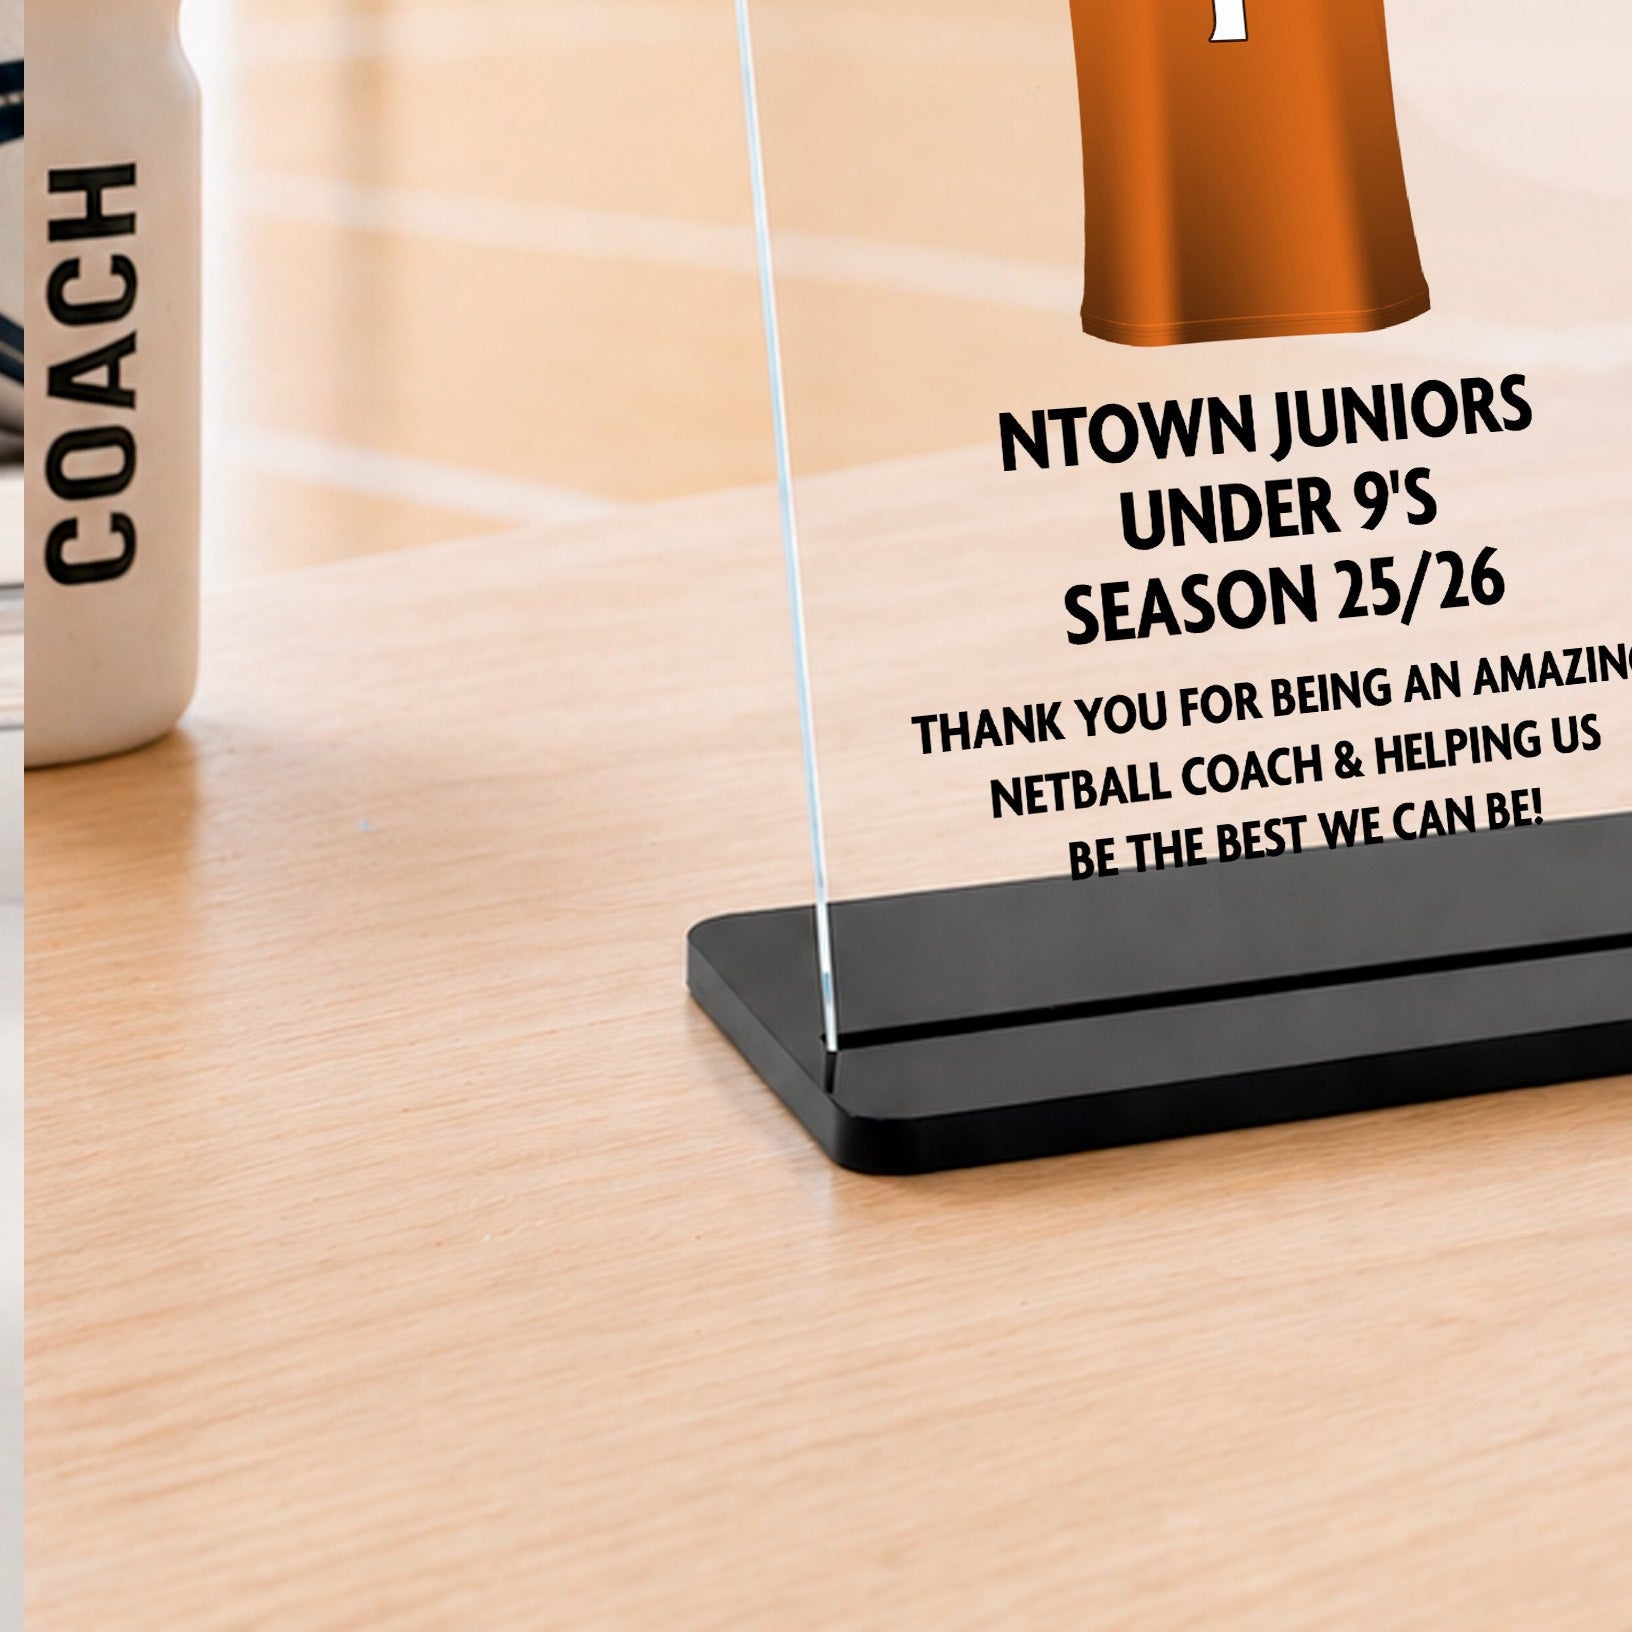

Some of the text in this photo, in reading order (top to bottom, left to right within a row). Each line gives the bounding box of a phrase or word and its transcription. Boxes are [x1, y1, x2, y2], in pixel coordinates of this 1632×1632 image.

[43, 162, 138, 587] COACH
[998, 373, 1533, 472] NTOWN JUNIORS
[1119, 466, 1437, 551] UNDER 9'S
[1064, 545, 1505, 646] SEASON 25/26
[910, 701, 1066, 755] THANK
[1073, 690, 1167, 737] YOU
[1179, 682, 1264, 727] FOR
[1270, 667, 1392, 717] BEING
[1404, 660, 1461, 703] AN
[990, 713, 1602, 819] NETBALL COACH & HELPING US
[1069, 787, 1542, 881] BE THE BEST WE CAN BE!
